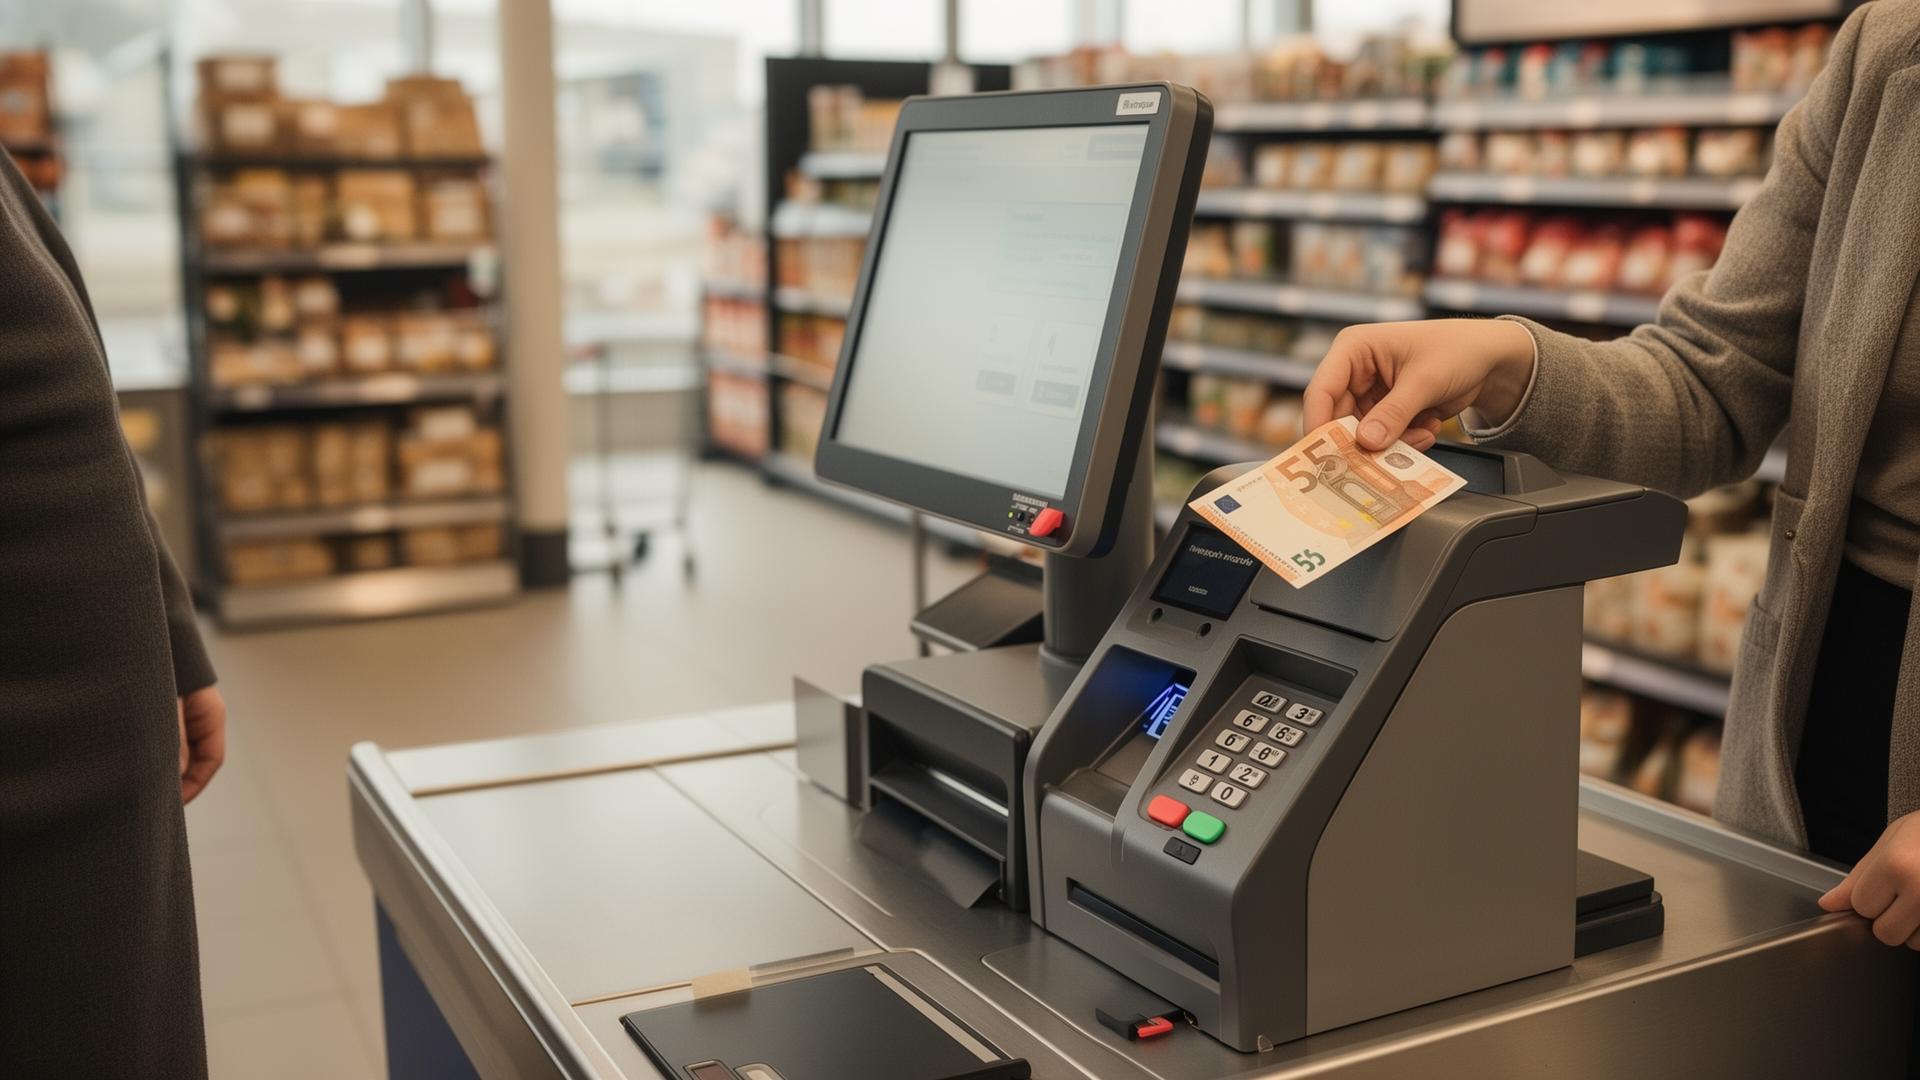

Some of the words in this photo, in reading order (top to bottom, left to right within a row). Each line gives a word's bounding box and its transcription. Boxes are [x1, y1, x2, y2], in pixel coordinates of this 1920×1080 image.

[1291, 549, 1326, 573] 55
[1295, 708, 1309, 719] 3
[1243, 715, 1256, 727] 6
[1208, 754, 1219, 768] 1
[1238, 768, 1252, 781] 2
[1220, 787, 1233, 800] 0
